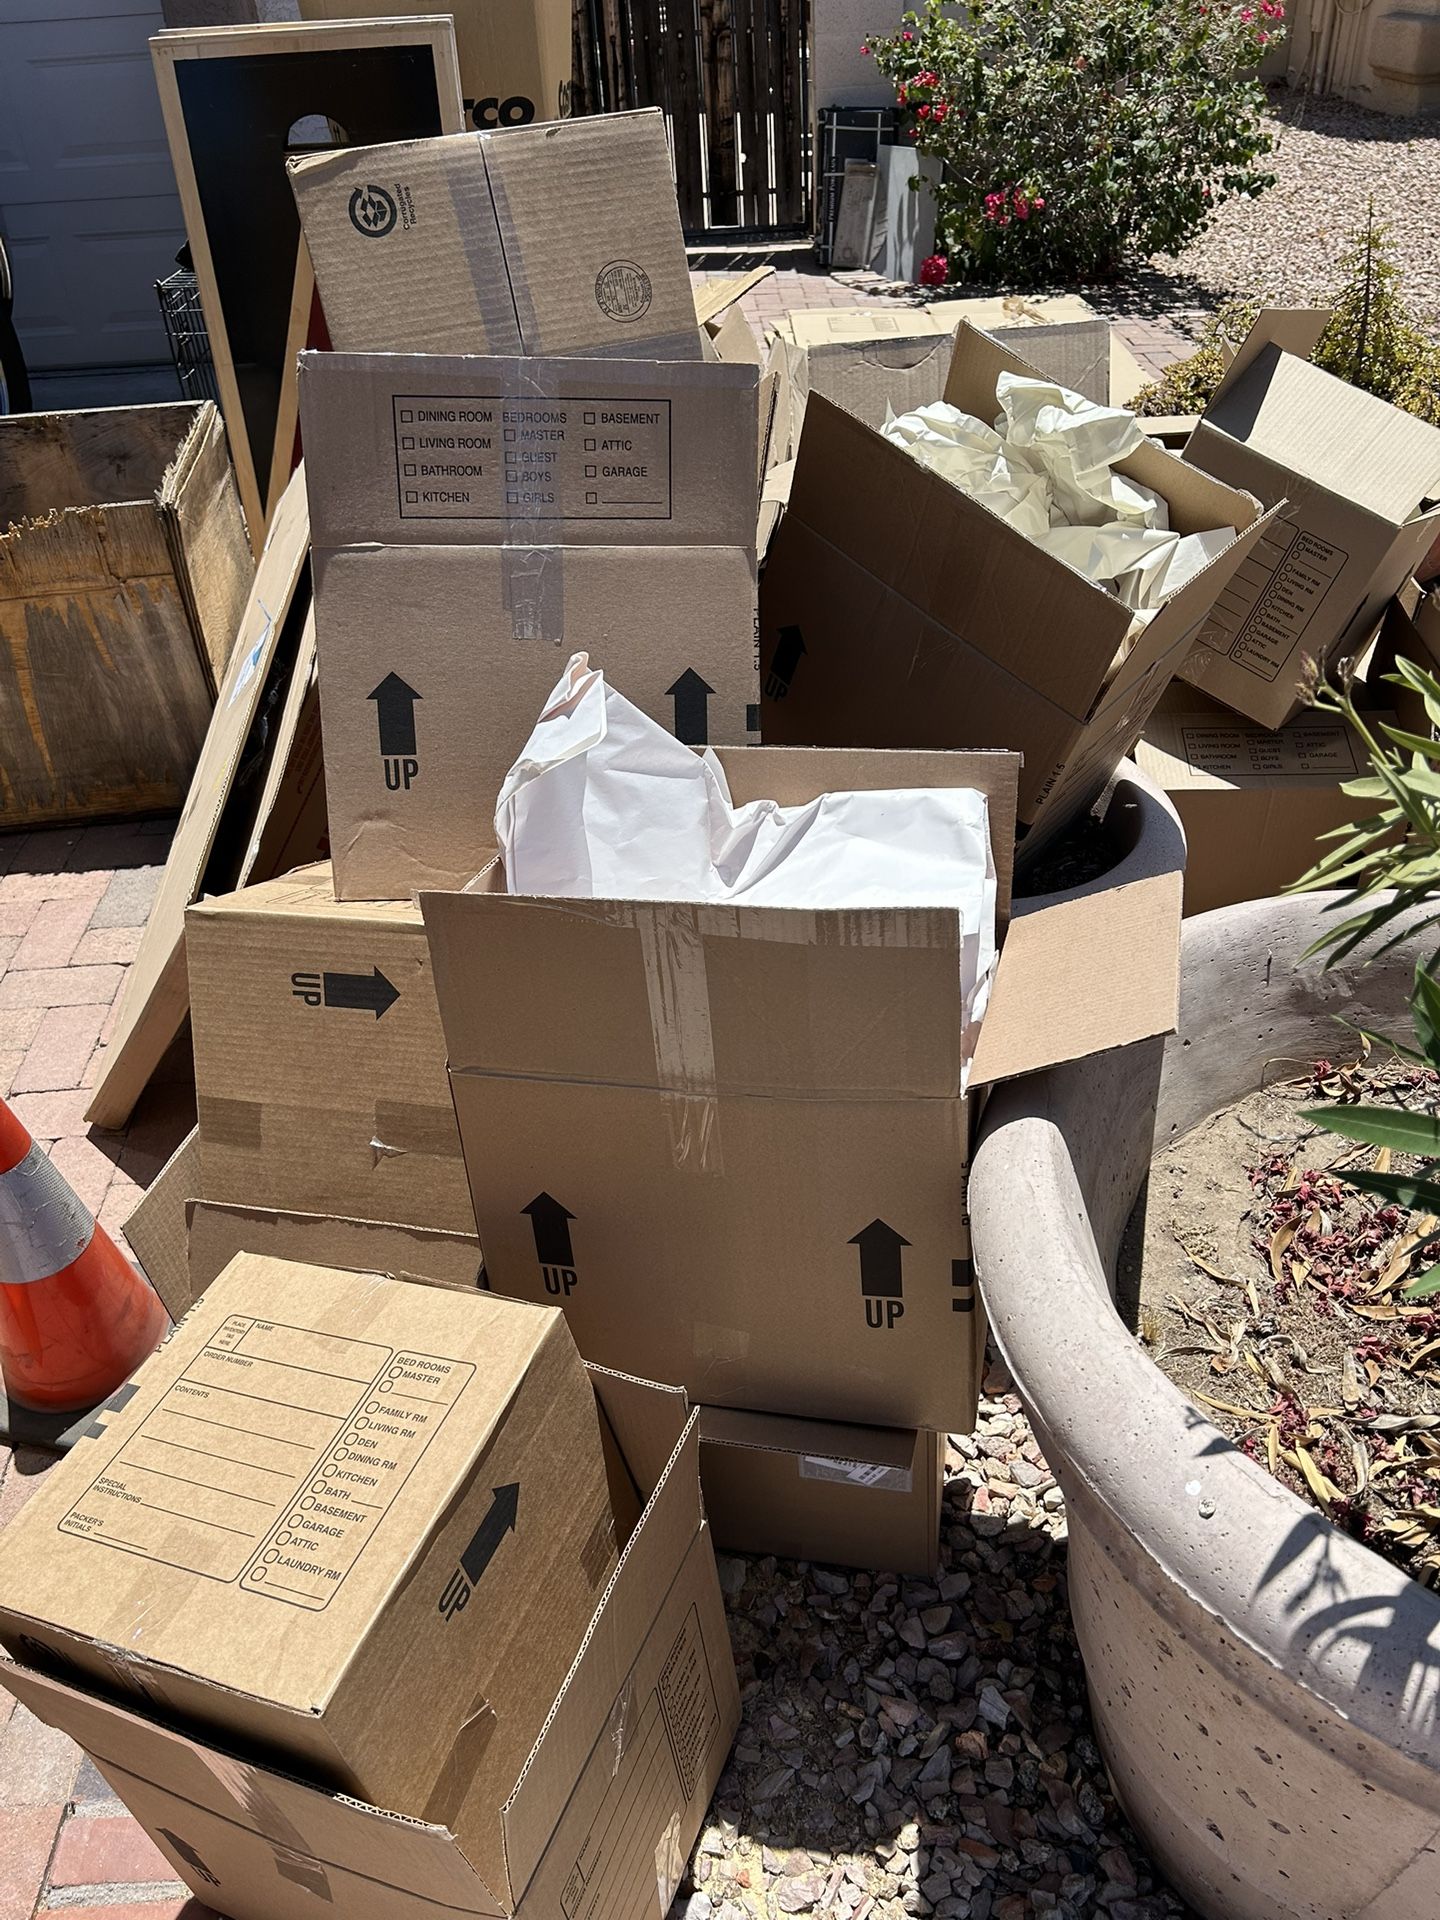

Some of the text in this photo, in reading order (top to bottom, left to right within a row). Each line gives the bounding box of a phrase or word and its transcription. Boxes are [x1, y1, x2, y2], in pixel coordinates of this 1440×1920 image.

[394, 184, 410, 230] Corrugated
[404, 186, 416, 224] Recycles
[418, 410, 492, 422] DINING ROOM
[502, 412, 567, 423] BEDROOMS
[601, 414, 660, 424] BASEMENT
[521, 430, 564, 441] MASTER
[420, 438, 491, 448] LIVING ROOM
[602, 440, 632, 450] ATTIC
[522, 452, 558, 463] GUEST
[421, 465, 482, 476] BATHROOM
[522, 472, 552, 482] BOYS
[602, 466, 648, 477] GARAGE
[423, 492, 470, 502] KITCHEN
[523, 493, 554, 503] GIRLS
[1301, 536, 1333, 556] BED ROOMS
[1305, 547, 1327, 562] MASTER
[1292, 569, 1311, 581] FAMILY
[1286, 577, 1305, 590] LIVING
[1281, 587, 1293, 596] DEN
[1277, 595, 1295, 607] DINING
[1266, 613, 1280, 623] BATH
[1271, 604, 1294, 620] KITCHEN
[1261, 621, 1290, 639] BASEMENT
[1251, 639, 1267, 649] ATTIC
[1256, 630, 1279, 645] GARAGE
[1246, 647, 1271, 663] LAUNDRY
[765, 673, 788, 702] UP
[384, 759, 418, 790] UP
[1035, 778, 1056, 804] PLAIN
[291, 972, 321, 1006] UP
[543, 1267, 577, 1296] UP
[866, 1299, 904, 1328] UP
[255, 1323, 275, 1332] NAME
[203, 1351, 254, 1368] ORDER NUMBER
[397, 1357, 451, 1374] BED ROOMS
[402, 1371, 440, 1384] MASTER
[175, 1385, 210, 1398] CONTENTS
[379, 1406, 428, 1423] FAMILY RM
[368, 1422, 416, 1438] LIVING RM
[357, 1438, 378, 1449] DEN
[348, 1452, 398, 1470] DINING RM
[99, 1477, 127, 1491] SPECIAL
[335, 1470, 378, 1487] KITCHEN
[93, 1485, 142, 1503] INSTRUCTIONS
[324, 1487, 351, 1500] BATH
[70, 1512, 104, 1526] PACKER'S
[314, 1503, 367, 1523] BASEMENT
[64, 1520, 92, 1532] INITIALS
[302, 1520, 345, 1538] GARAGE
[289, 1537, 319, 1551] ATTIC
[277, 1555, 342, 1580] LAUNDRY RM
[439, 1568, 470, 1622] UP
[191, 1865, 221, 1887] UP
